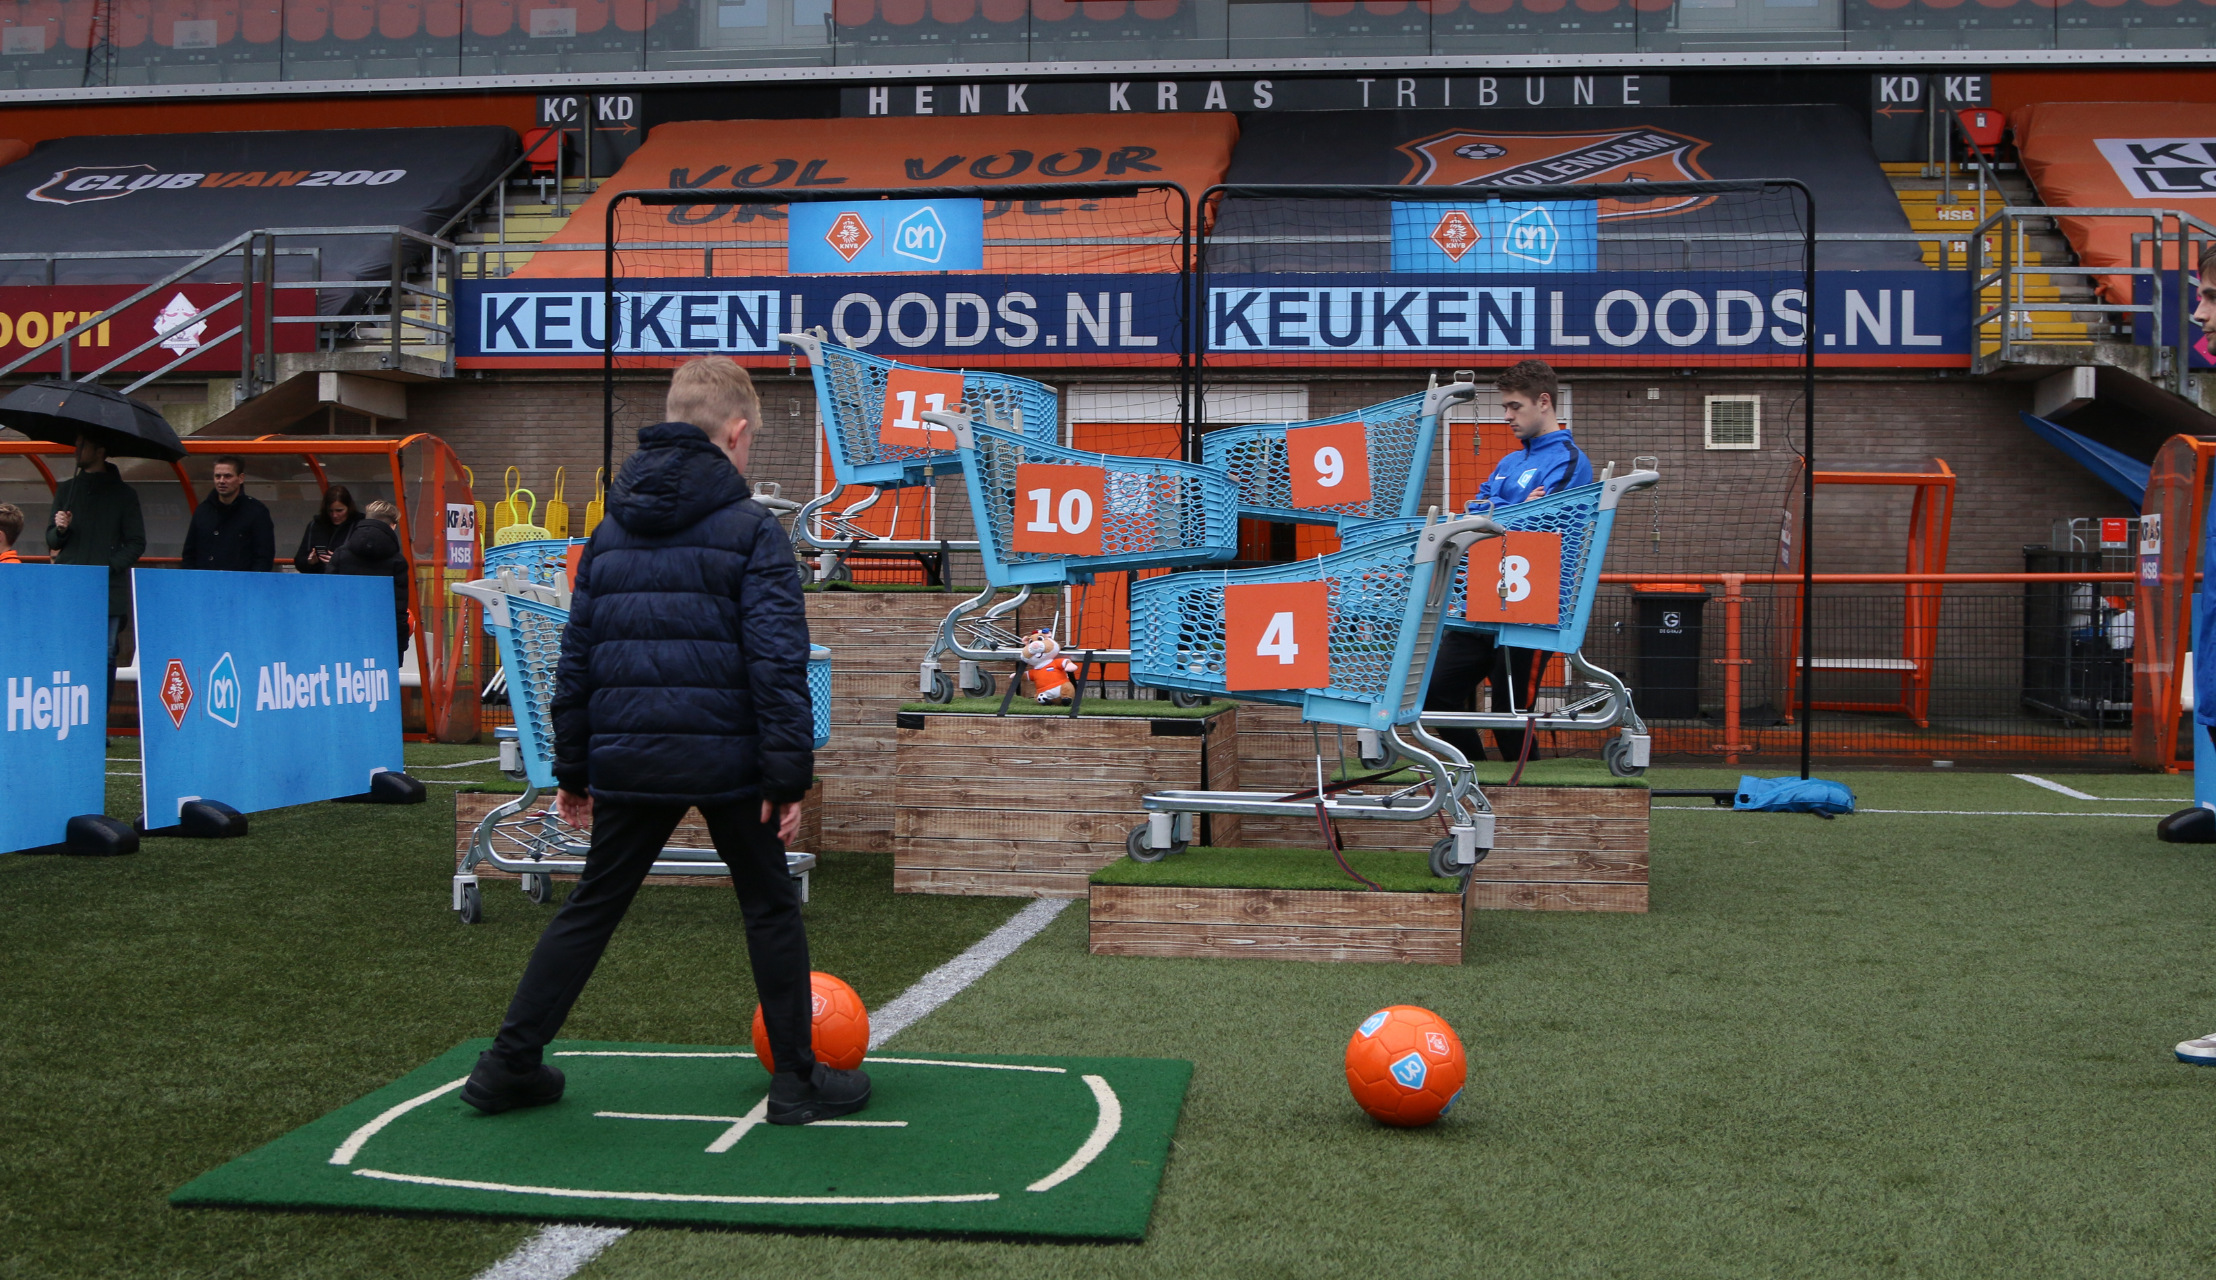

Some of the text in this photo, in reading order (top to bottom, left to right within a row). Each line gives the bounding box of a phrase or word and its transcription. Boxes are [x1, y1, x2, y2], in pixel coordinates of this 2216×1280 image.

[544, 97, 578, 122] KC
[598, 96, 634, 121] KD
[868, 75, 1641, 115] HENK KRAS TRIBUNE
[1880, 76, 1920, 102] KD
[1944, 76, 1982, 102] KE
[668, 145, 1163, 190] VOL VOOR
[1478, 134, 1679, 185] OLENDAM
[2125, 142, 2216, 165] K
[65, 168, 407, 192] CLUBVAN200
[1937, 210, 1975, 220] HSB
[486, 294, 769, 350] KEUKEN
[1214, 288, 1942, 348] KEUKEN LOODS.NL
[1313, 446, 1345, 488] 9
[1026, 487, 1093, 535] 10
[451, 547, 471, 563] HSB
[2142, 561, 2158, 580] HSB
[1496, 555, 1531, 602] 8
[1256, 612, 1299, 665] 4
[7, 670, 90, 741] Heijn
[256, 657, 390, 713] Albert Heijn
